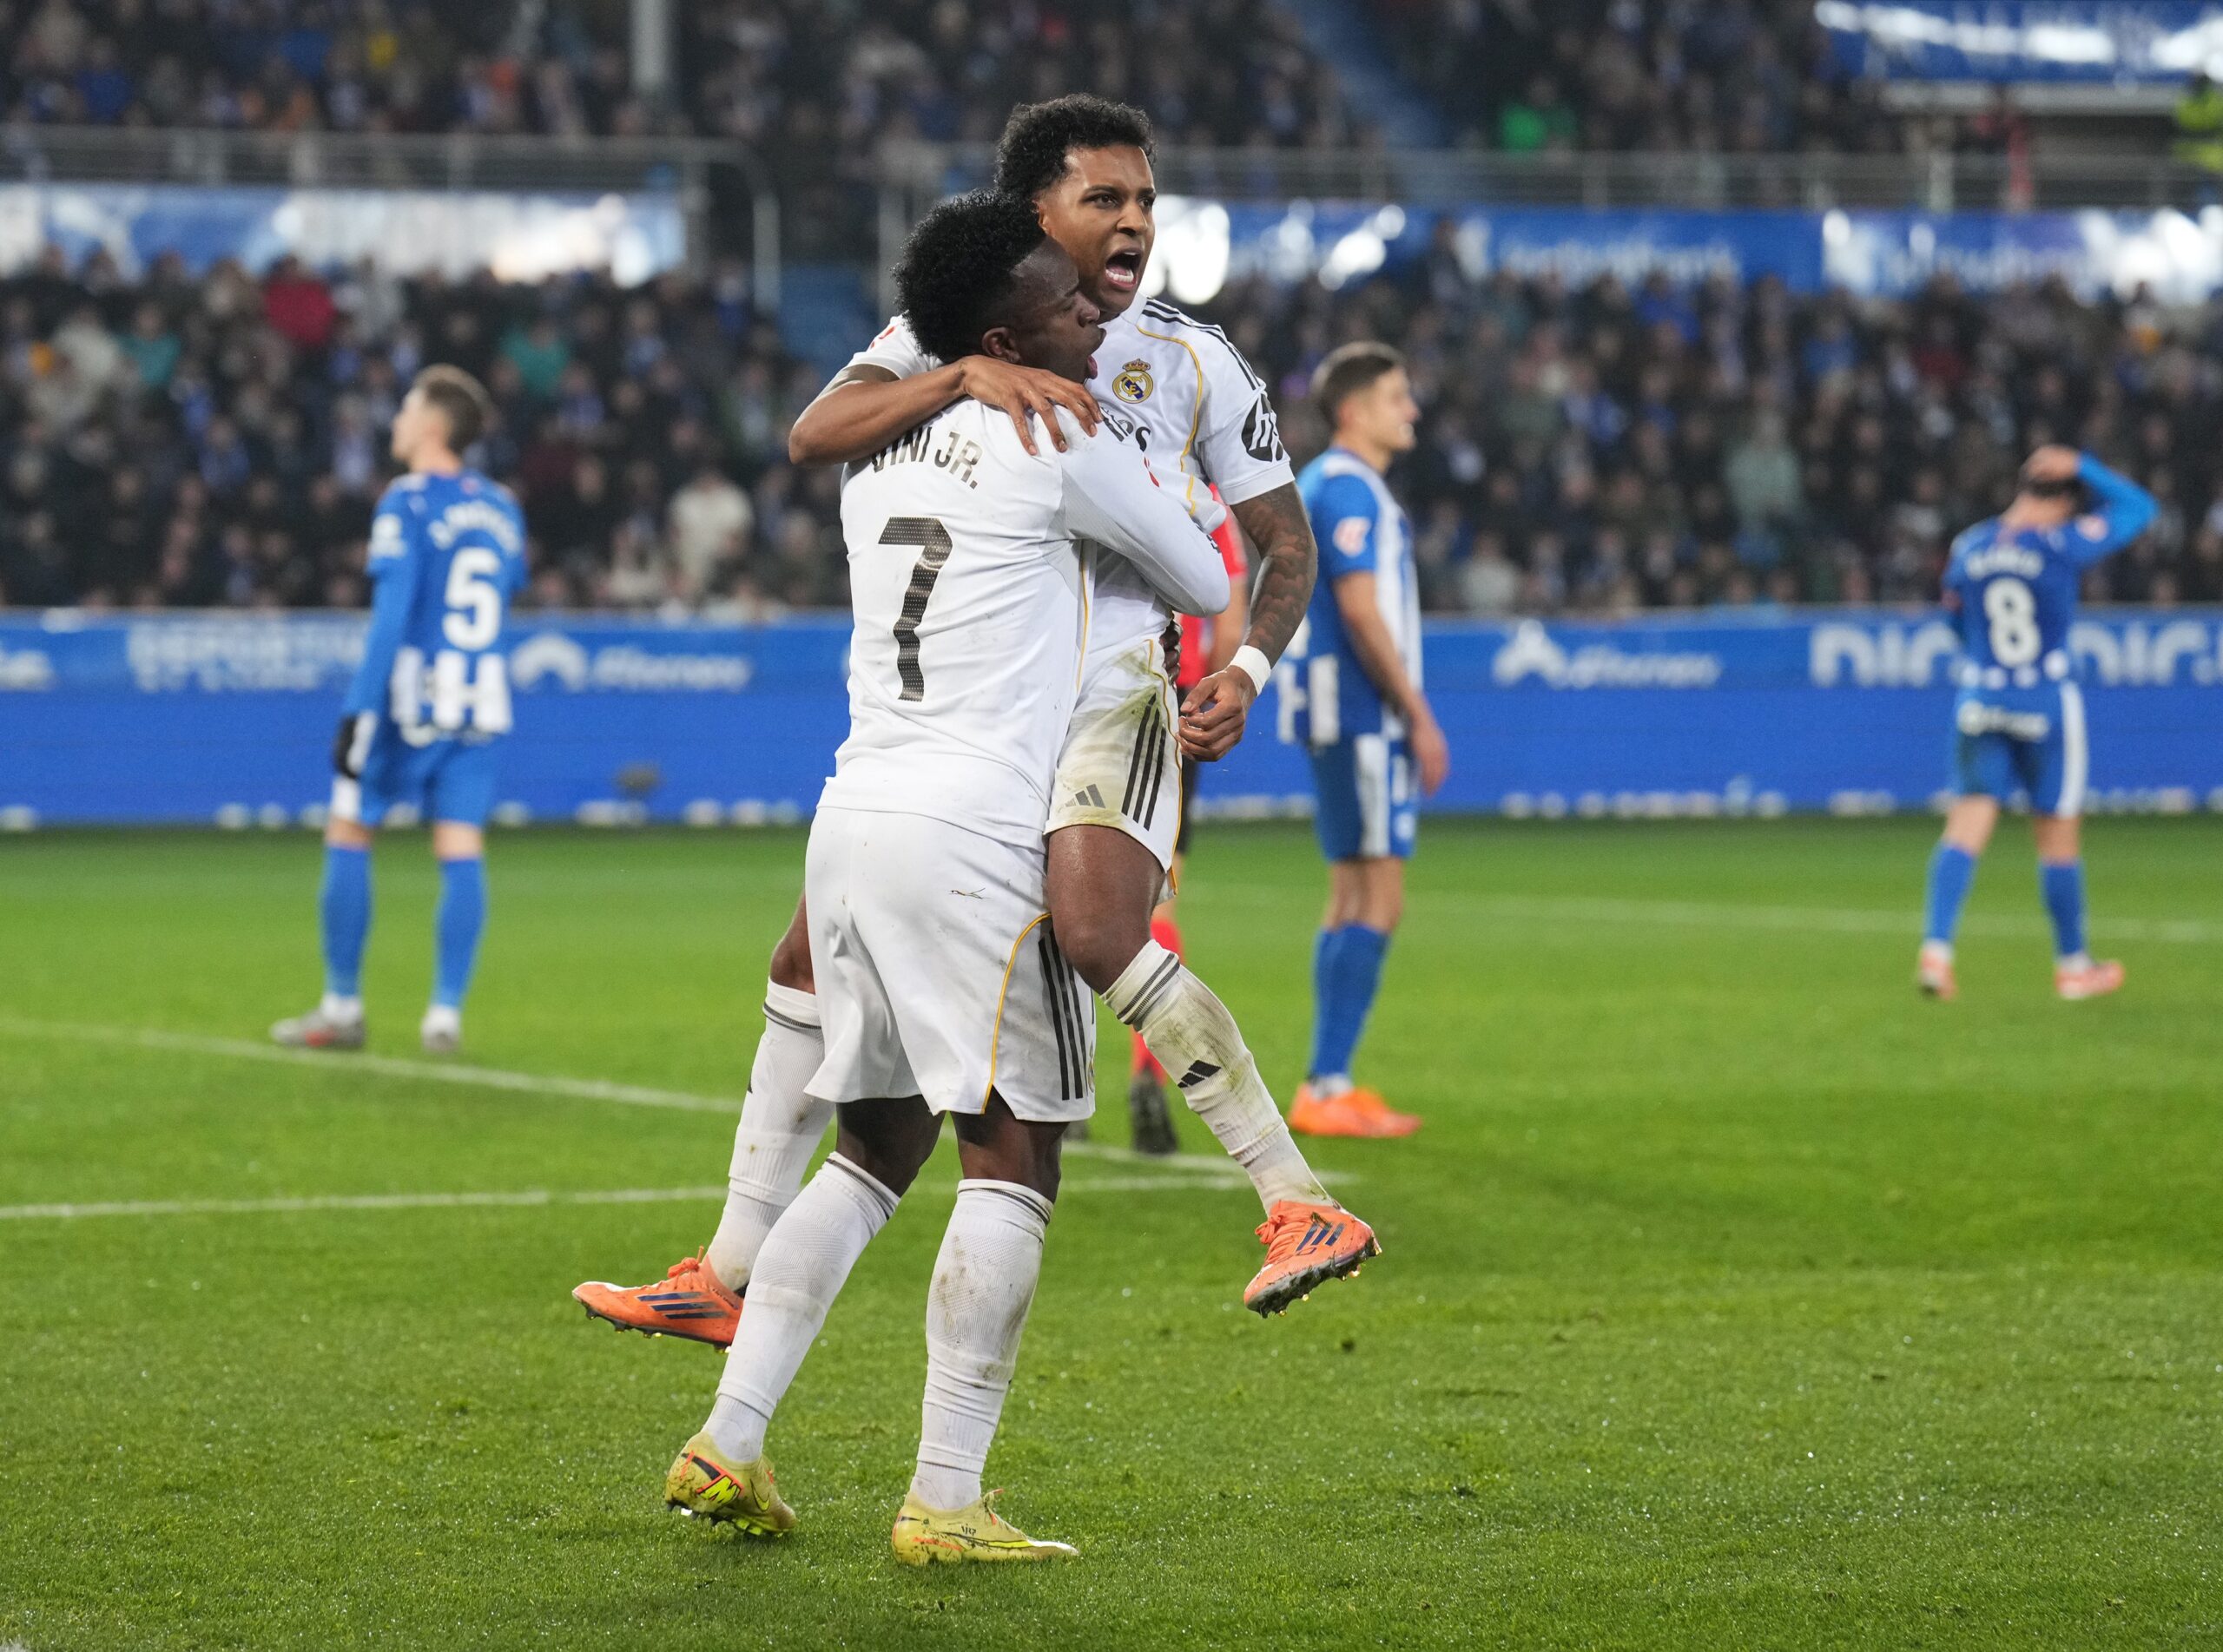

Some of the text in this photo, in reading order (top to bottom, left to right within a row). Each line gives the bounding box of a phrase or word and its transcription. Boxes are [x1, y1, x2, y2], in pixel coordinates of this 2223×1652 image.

[934, 431, 983, 490] JR.
[442, 546, 501, 651] 5
[878, 517, 953, 701] 7
[1984, 576, 2041, 668] 8
